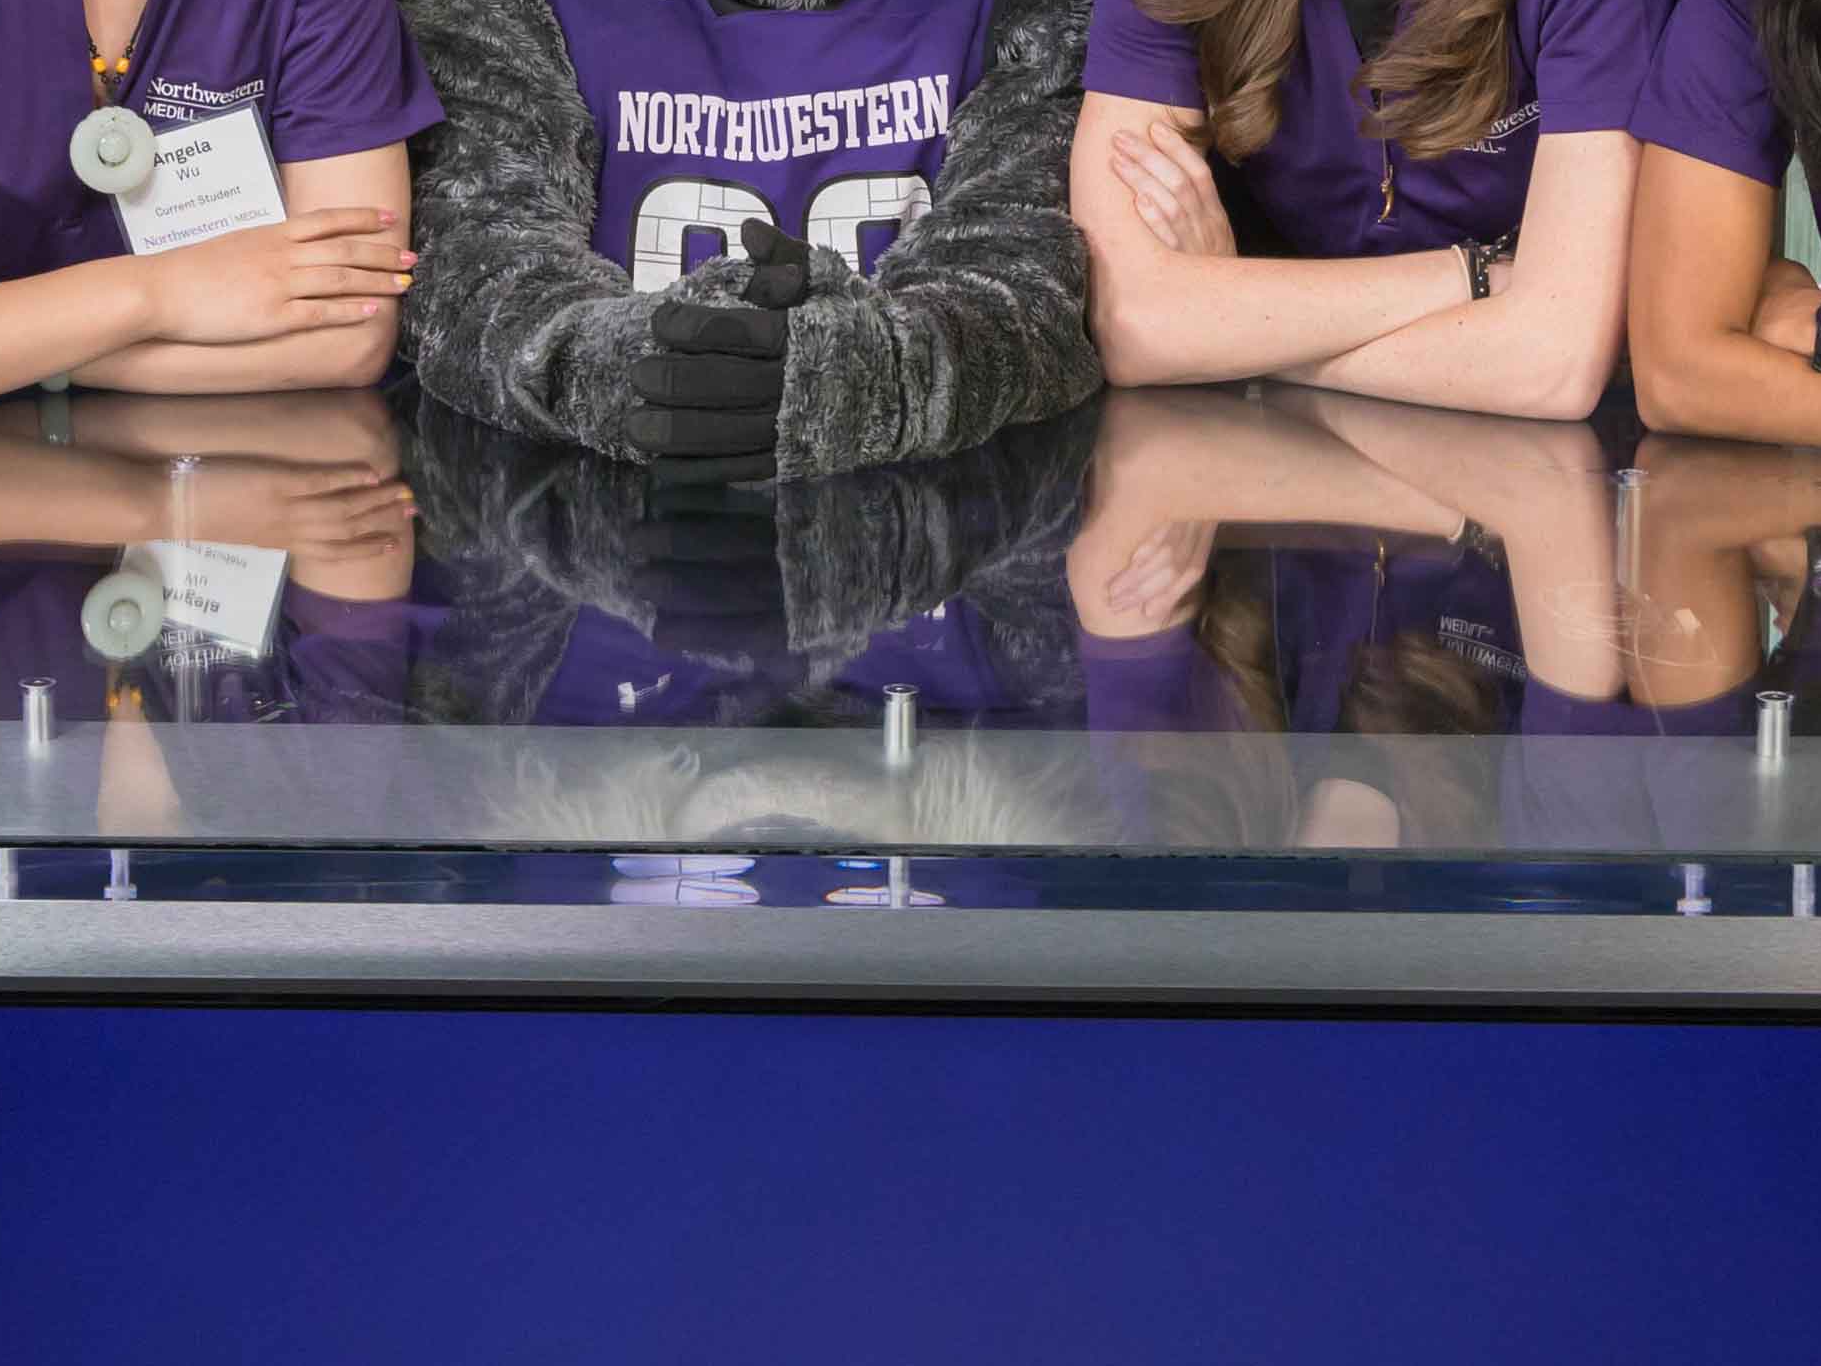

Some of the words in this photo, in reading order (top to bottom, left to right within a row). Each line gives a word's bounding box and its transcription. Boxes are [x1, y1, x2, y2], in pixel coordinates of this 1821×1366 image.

[148, 77, 265, 105] Northwestern
[143, 101, 198, 122] MEDILL
[617, 74, 950, 162] NORTHWESTERN
[153, 138, 213, 168] Angela
[176, 165, 201, 182] Wu
[154, 198, 195, 218] Current
[197, 184, 242, 205] Student
[144, 217, 229, 249] Northwestern
